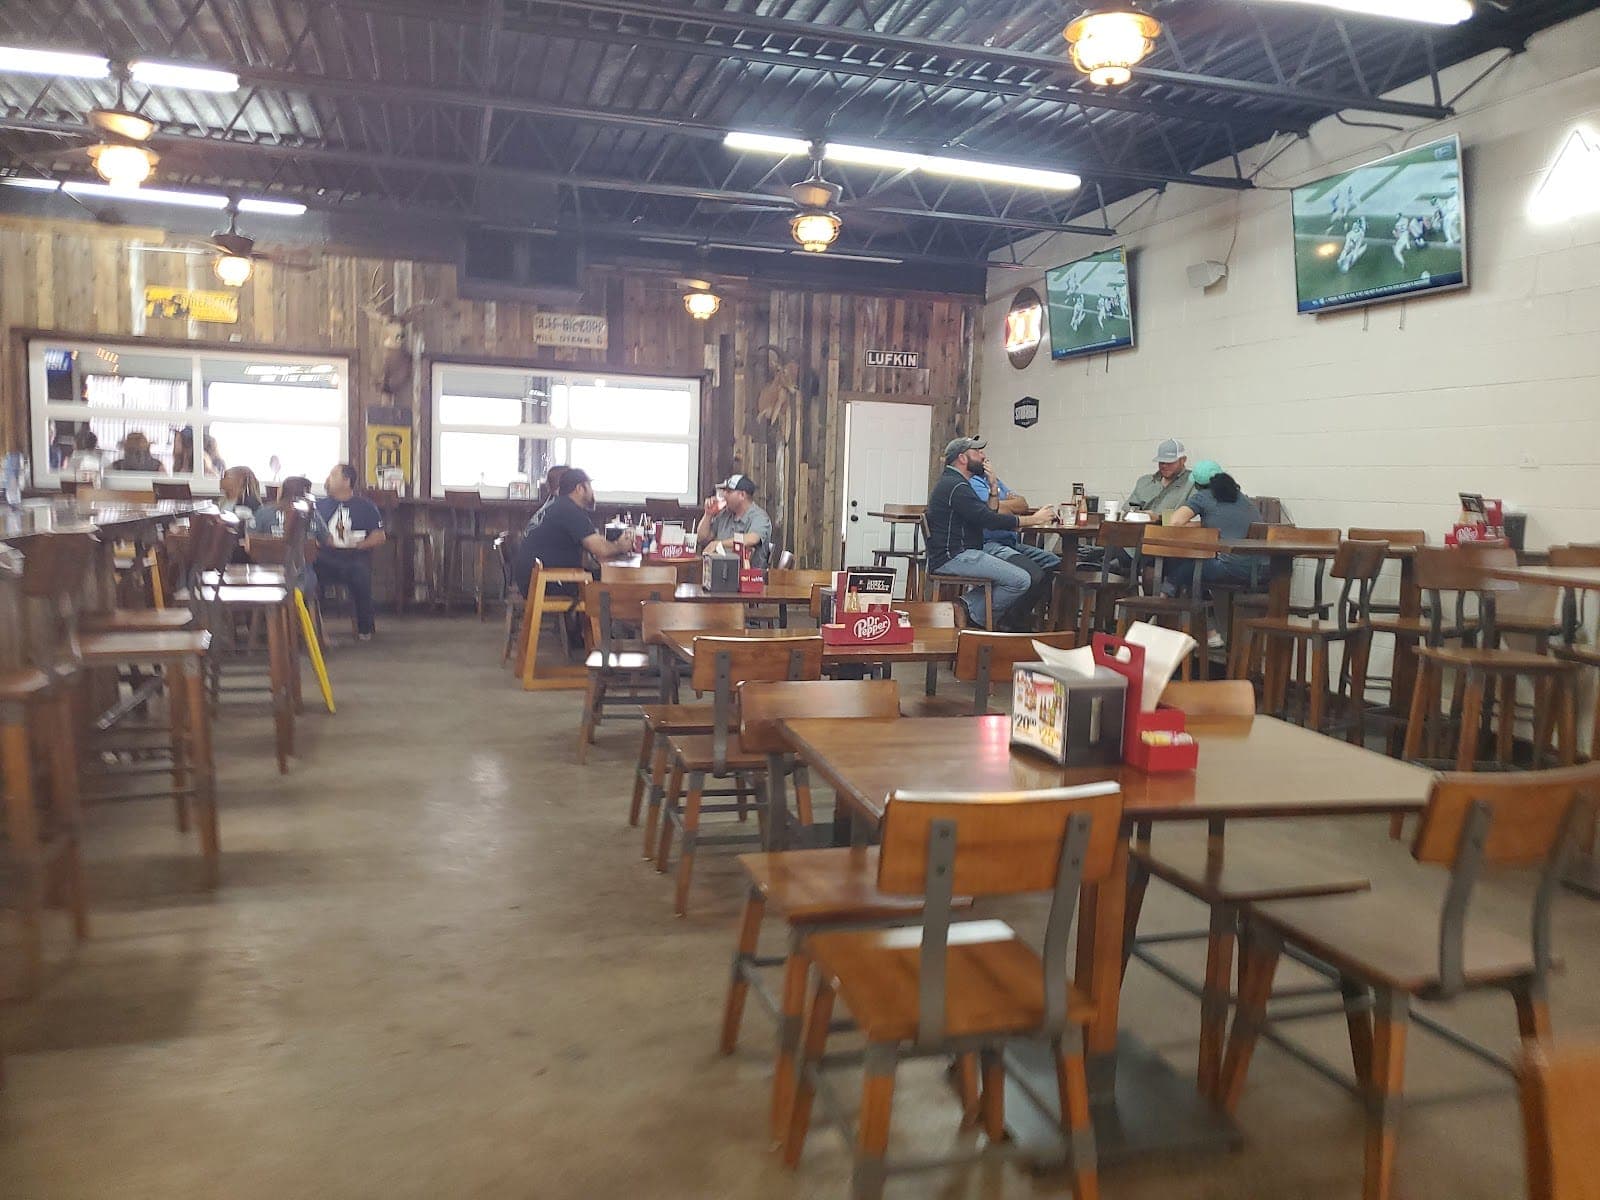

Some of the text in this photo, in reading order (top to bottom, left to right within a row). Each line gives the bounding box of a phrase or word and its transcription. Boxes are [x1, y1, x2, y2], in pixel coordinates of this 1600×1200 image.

[868, 352, 917, 367] LUFKIN
[856, 618, 888, 638] Pepper
[866, 616, 880, 627] Dr
